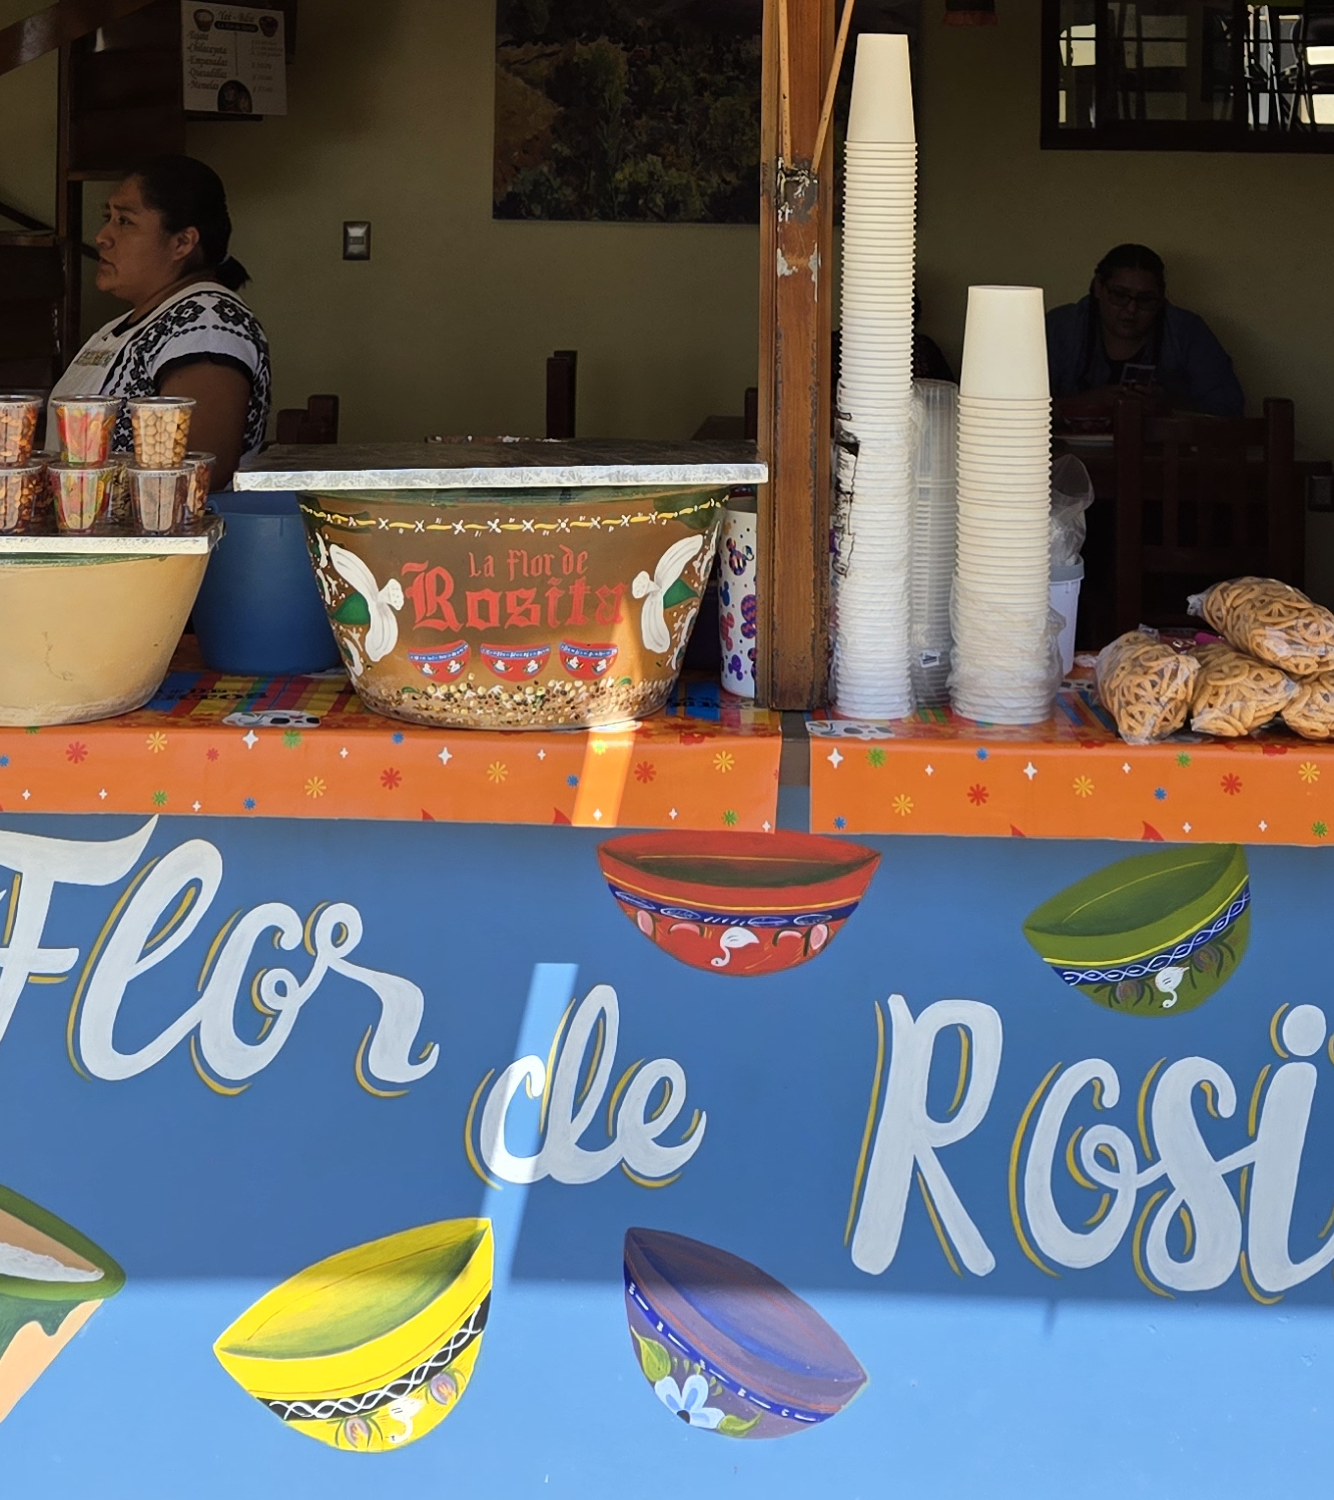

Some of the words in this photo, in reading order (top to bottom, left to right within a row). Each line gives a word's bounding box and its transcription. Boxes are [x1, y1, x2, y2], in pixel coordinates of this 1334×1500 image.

[559, 544, 589, 575] de
[402, 560, 629, 632] Rosita
[468, 984, 706, 1188] de
